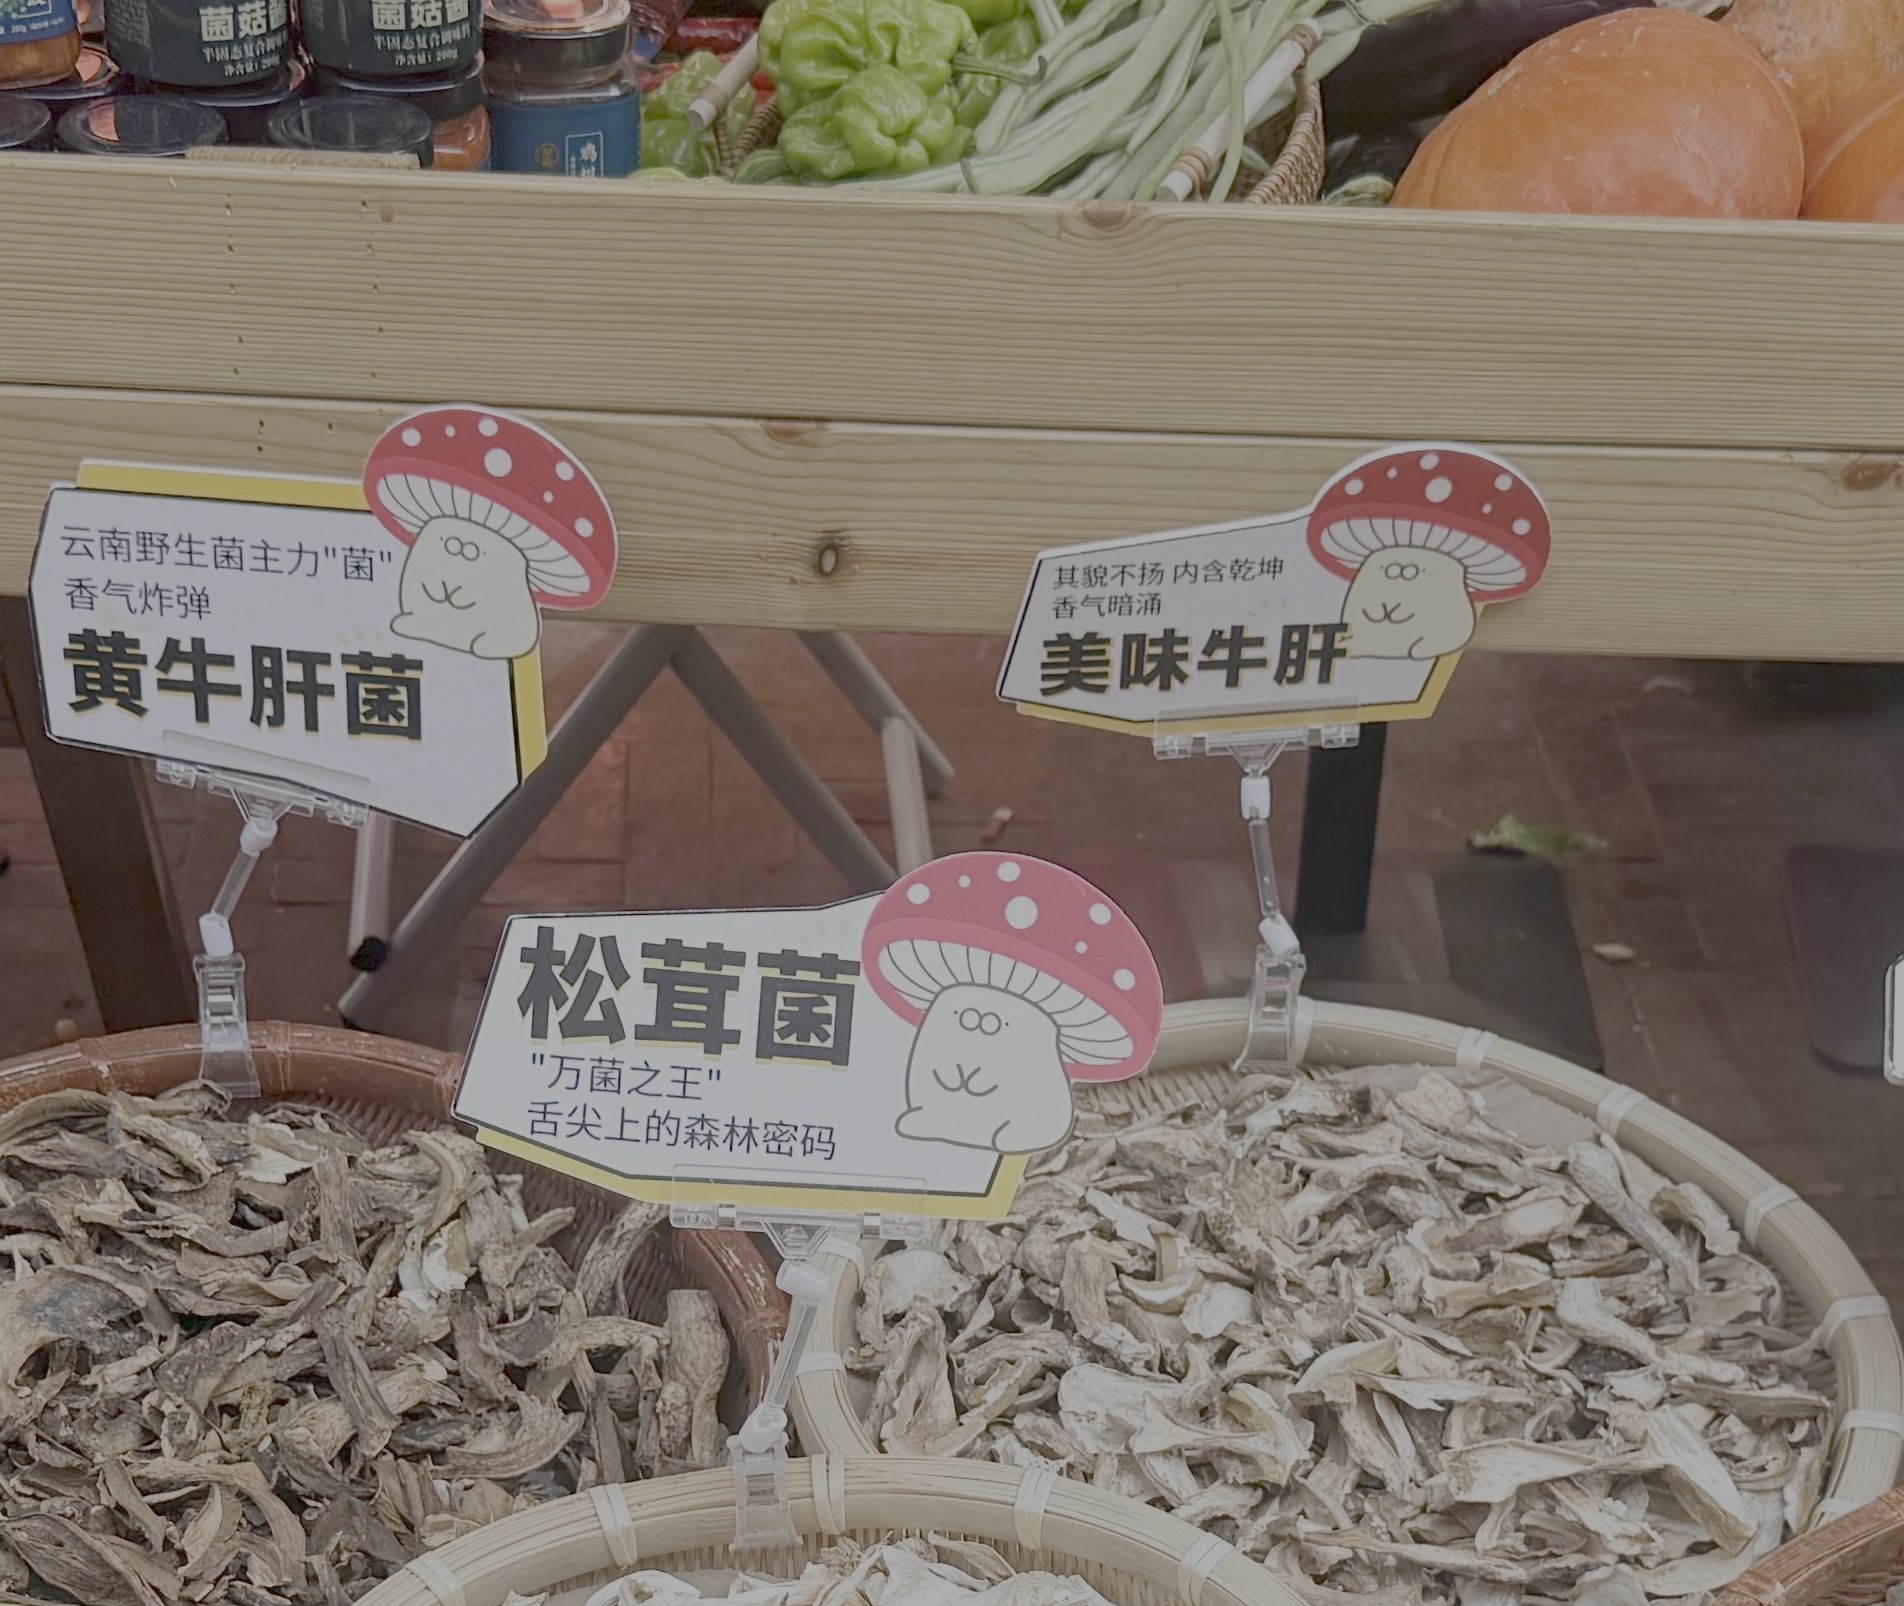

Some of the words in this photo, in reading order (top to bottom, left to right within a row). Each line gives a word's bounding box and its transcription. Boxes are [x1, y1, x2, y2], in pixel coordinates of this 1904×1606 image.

[61, 526, 392, 582] 云南野生菌主力"菌"
[1053, 563, 1164, 589] 其貌不扬
[1173, 556, 1283, 585] 内含乾坤
[64, 577, 211, 620] 香气炸弹
[1052, 592, 1162, 619] 香气暗涌
[63, 629, 424, 742] 黄牛肝菌
[1040, 622, 1351, 696] 美味牛肝
[517, 927, 860, 1070] 松茸菌
[531, 1054, 721, 1101] "万菌之王"
[527, 1102, 836, 1161] 舌尖上的森林密码
